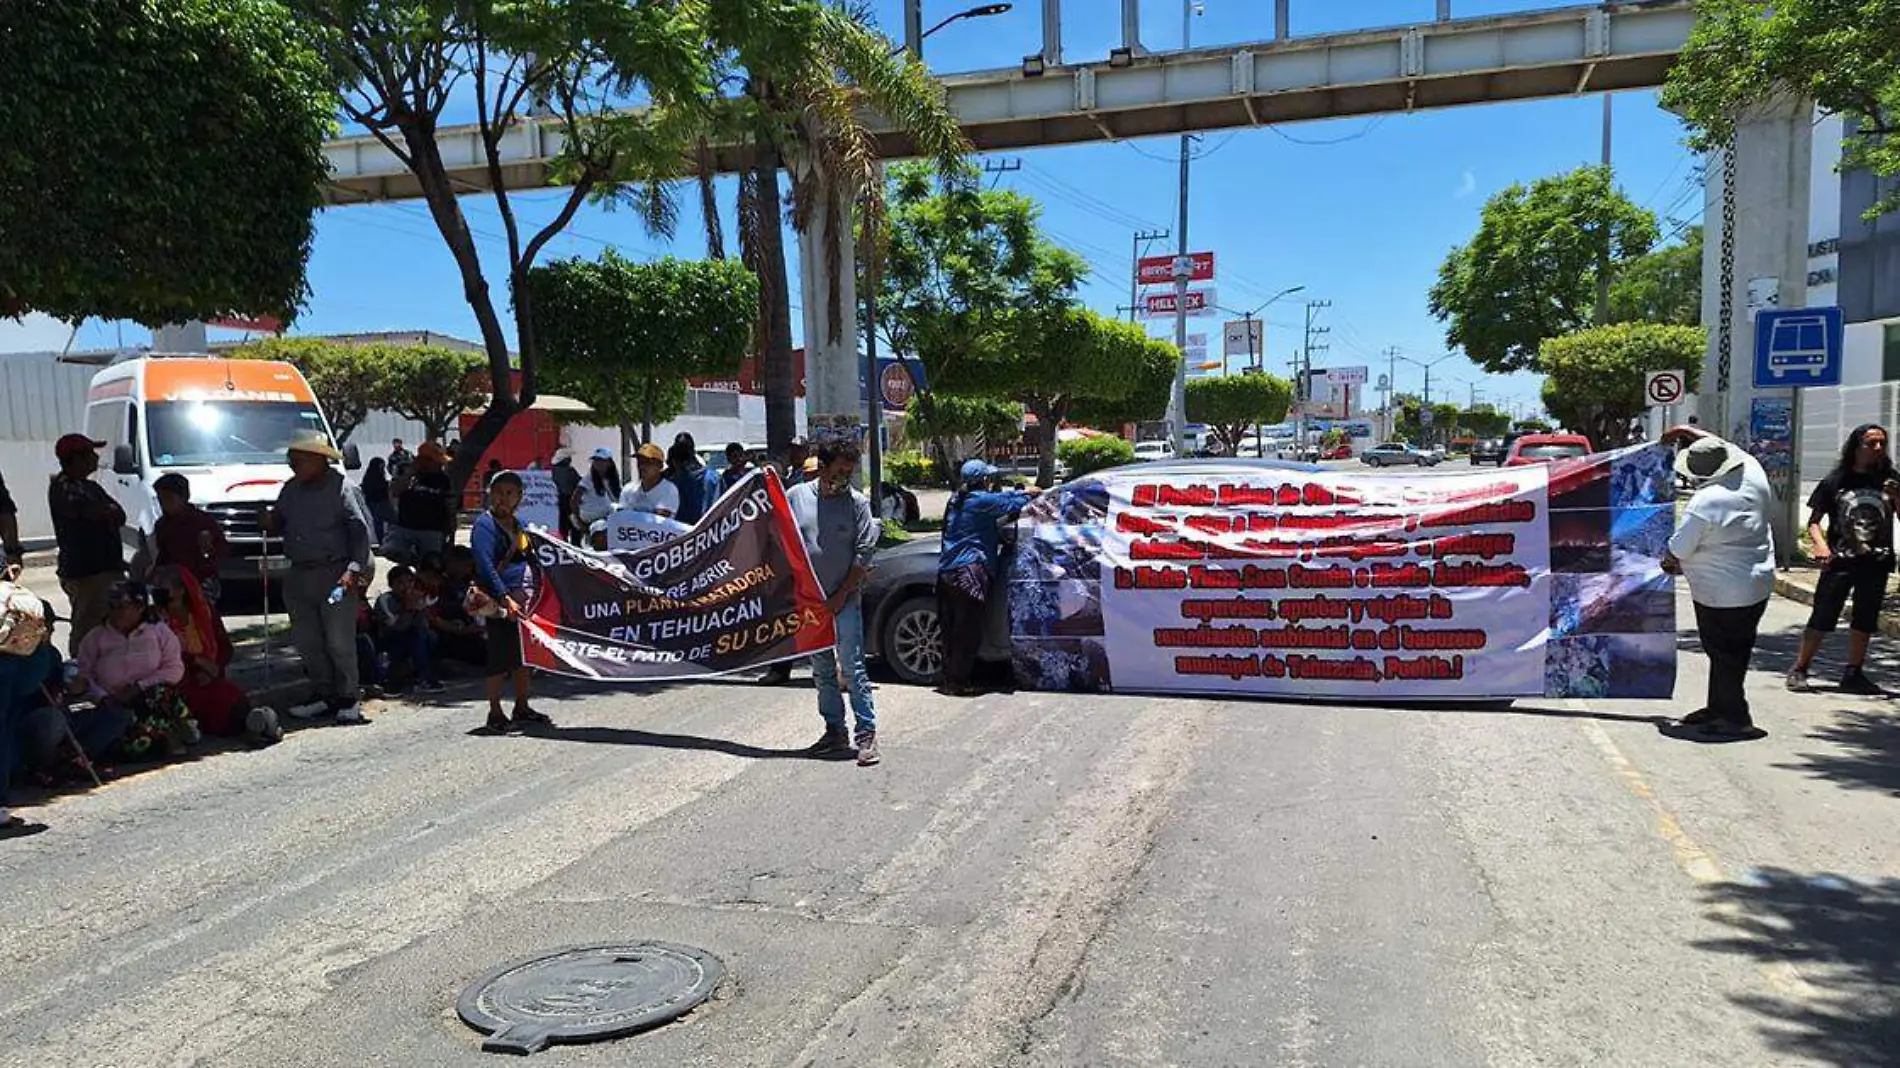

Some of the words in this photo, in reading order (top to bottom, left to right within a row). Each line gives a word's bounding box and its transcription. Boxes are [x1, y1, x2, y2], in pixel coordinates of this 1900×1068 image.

[633, 488, 773, 579] GOBERNADOR
[691, 559, 735, 593] ABRIR
[1134, 566, 1187, 589] Madre
[1371, 562, 1430, 588] Medio
[584, 602, 622, 620] UNA
[610, 624, 641, 642] EN
[648, 597, 763, 641] TEHUACÁN
[1181, 595, 1276, 622] supervisar,
[1278, 593, 1349, 623] aprobar
[1350, 600, 1363, 623] y
[1365, 594, 1429, 624] vigilar
[1430, 593, 1453, 619] la
[602, 647, 628, 661] EL
[632, 650, 685, 663] PATIO
[688, 644, 712, 661] DE
[716, 630, 748, 655] SU
[753, 610, 821, 645] CASA
[1154, 624, 1258, 647] remediación
[1260, 624, 1350, 648] ambiental
[1351, 629, 1377, 649] en
[1379, 625, 1399, 649] el
[1402, 624, 1487, 650] basurero
[1175, 654, 1261, 680] municipal
[1262, 654, 1285, 678] de
[1286, 654, 1381, 683] Tehuacán,
